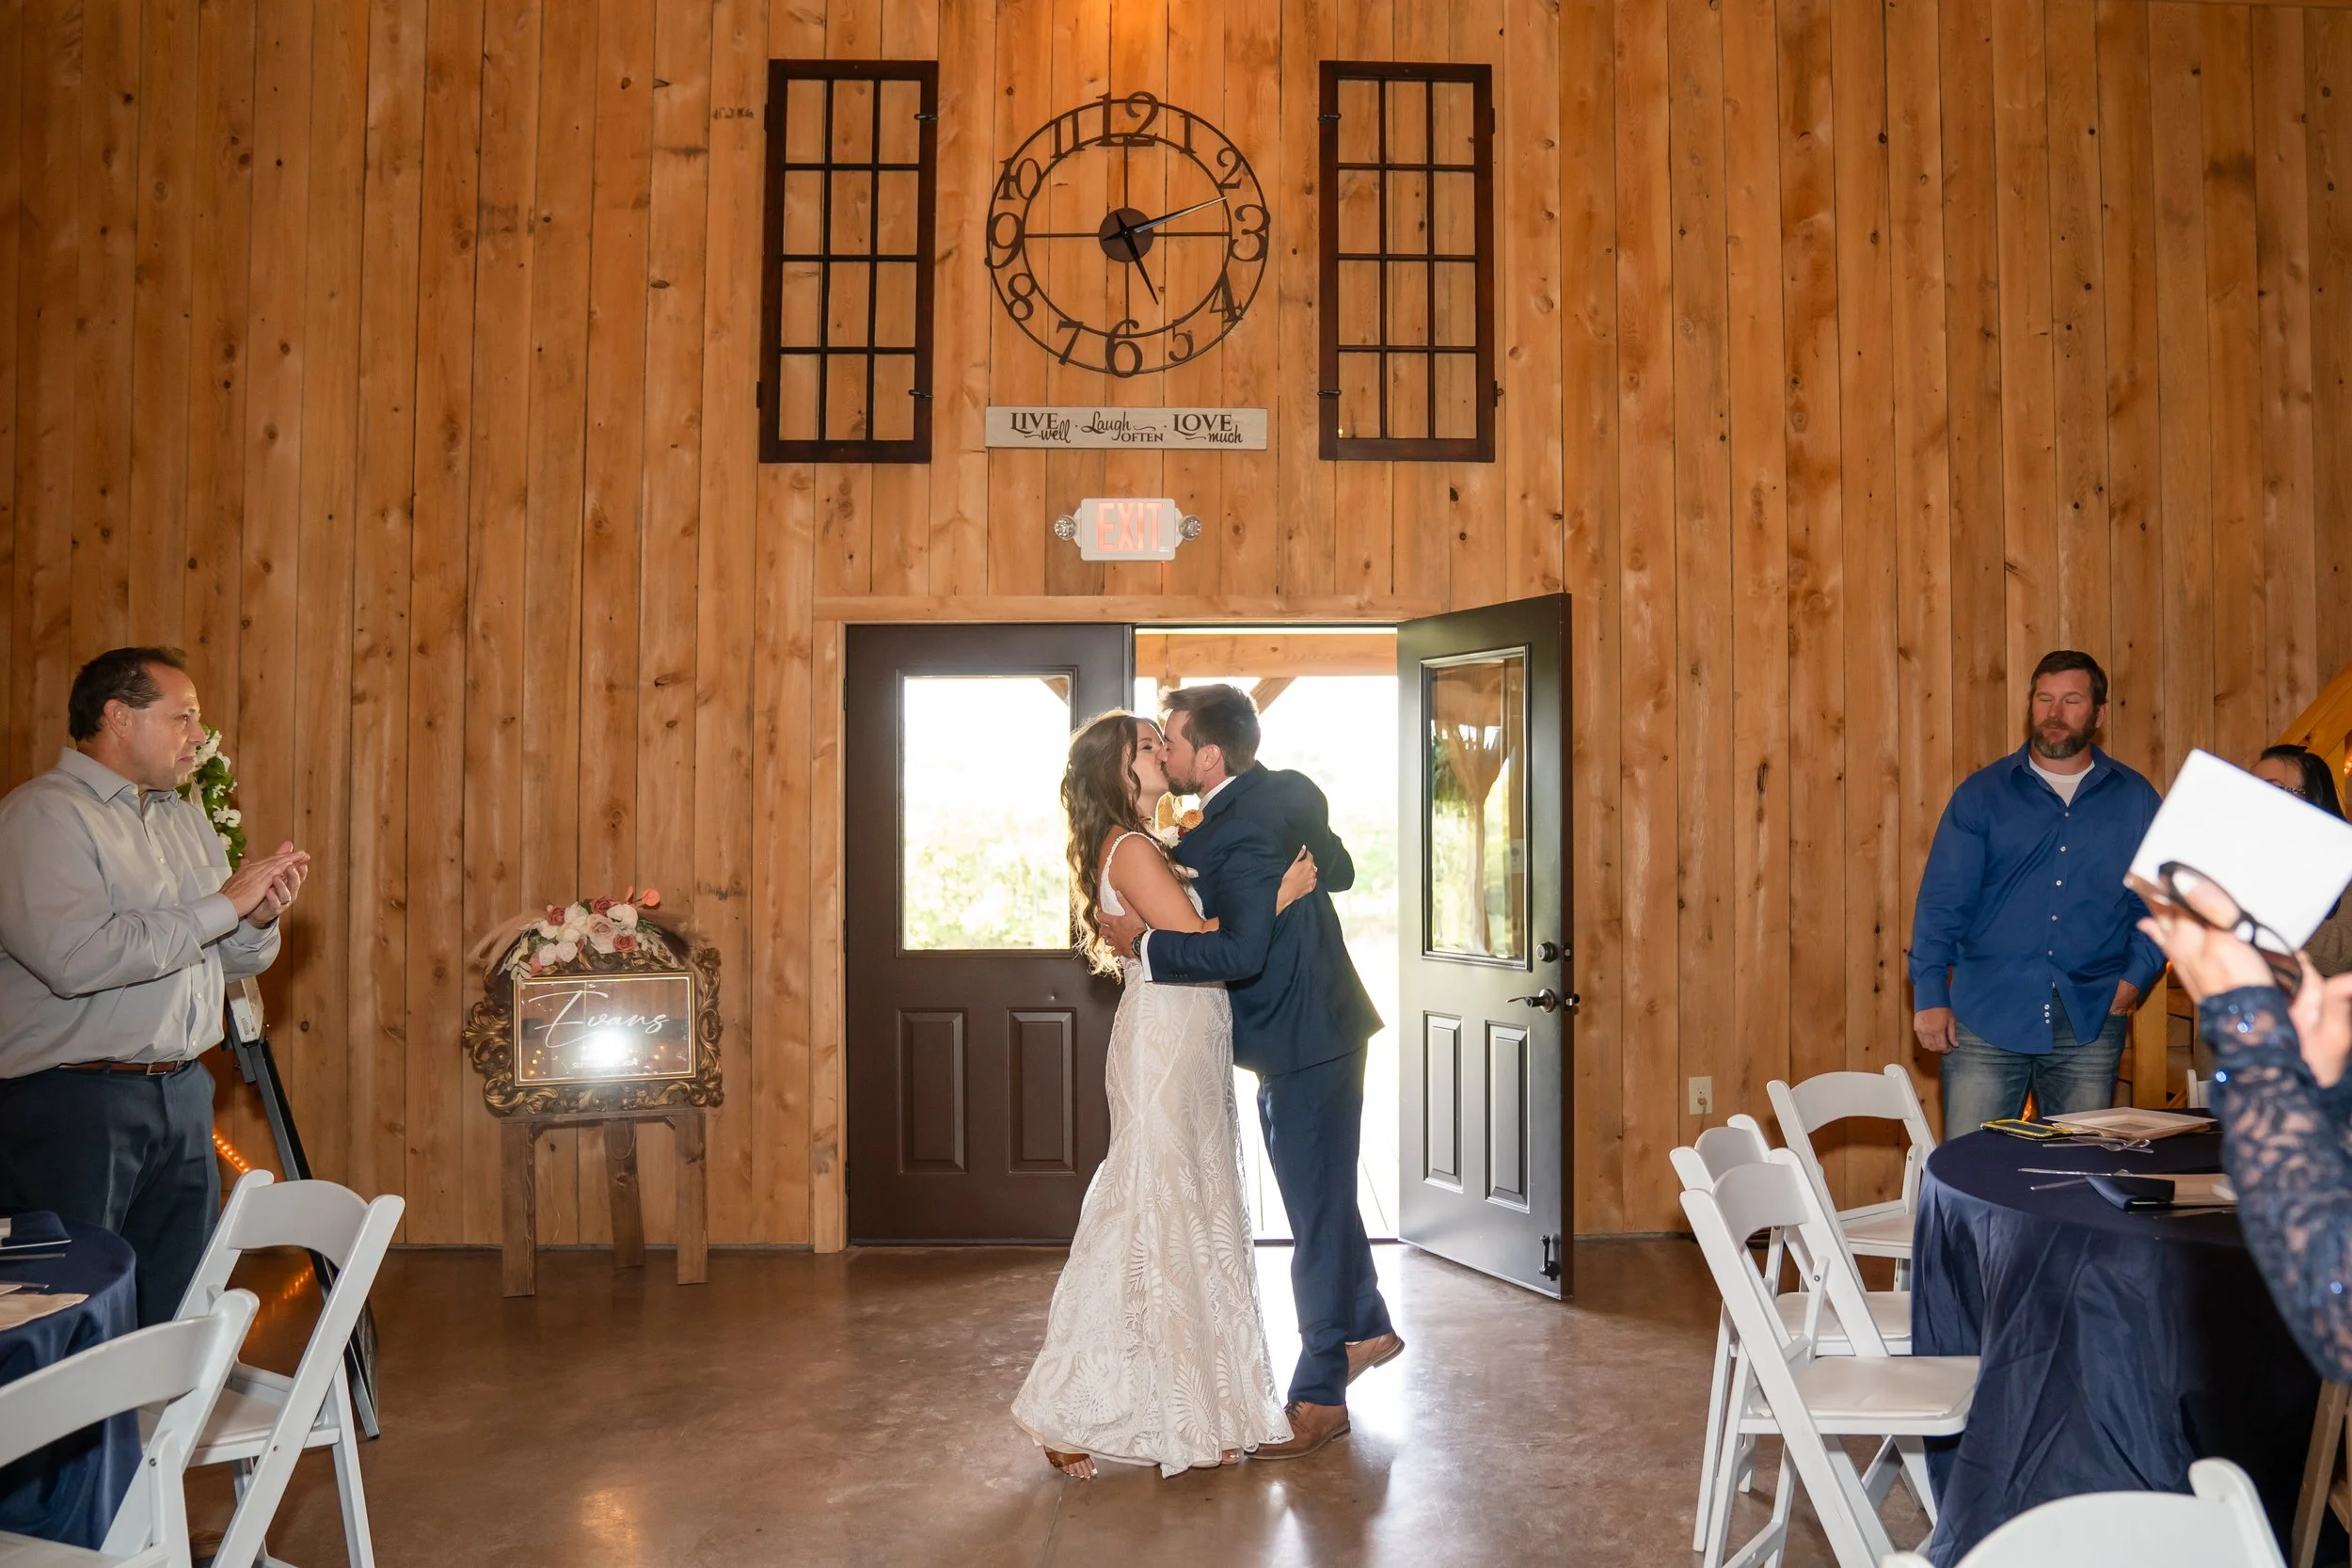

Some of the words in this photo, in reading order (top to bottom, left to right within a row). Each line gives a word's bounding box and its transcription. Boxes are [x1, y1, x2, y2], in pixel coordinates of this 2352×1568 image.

[1050, 110, 1086, 158] 11
[1096, 91, 1159, 147] 12
[1179, 112, 1197, 154] 1
[997, 158, 1042, 200] 10
[1216, 147, 1242, 189] 2
[984, 212, 1025, 269] 9
[1230, 204, 1271, 261] 3
[1008, 273, 1036, 321] 8
[1209, 269, 1244, 324] 4
[1056, 320, 1084, 365] 7
[1105, 319, 1143, 378] 6
[1168, 318, 1194, 362] 5
[1010, 412, 1058, 434] LIVE
[1041, 419, 1072, 443] well
[1081, 410, 1131, 440] Laugh
[1120, 433, 1164, 442] OFTEN
[1173, 413, 1232, 436] LOVE
[1207, 424, 1243, 443] much
[1096, 502, 1164, 552] EXIT
[529, 990, 670, 1049] Evans
